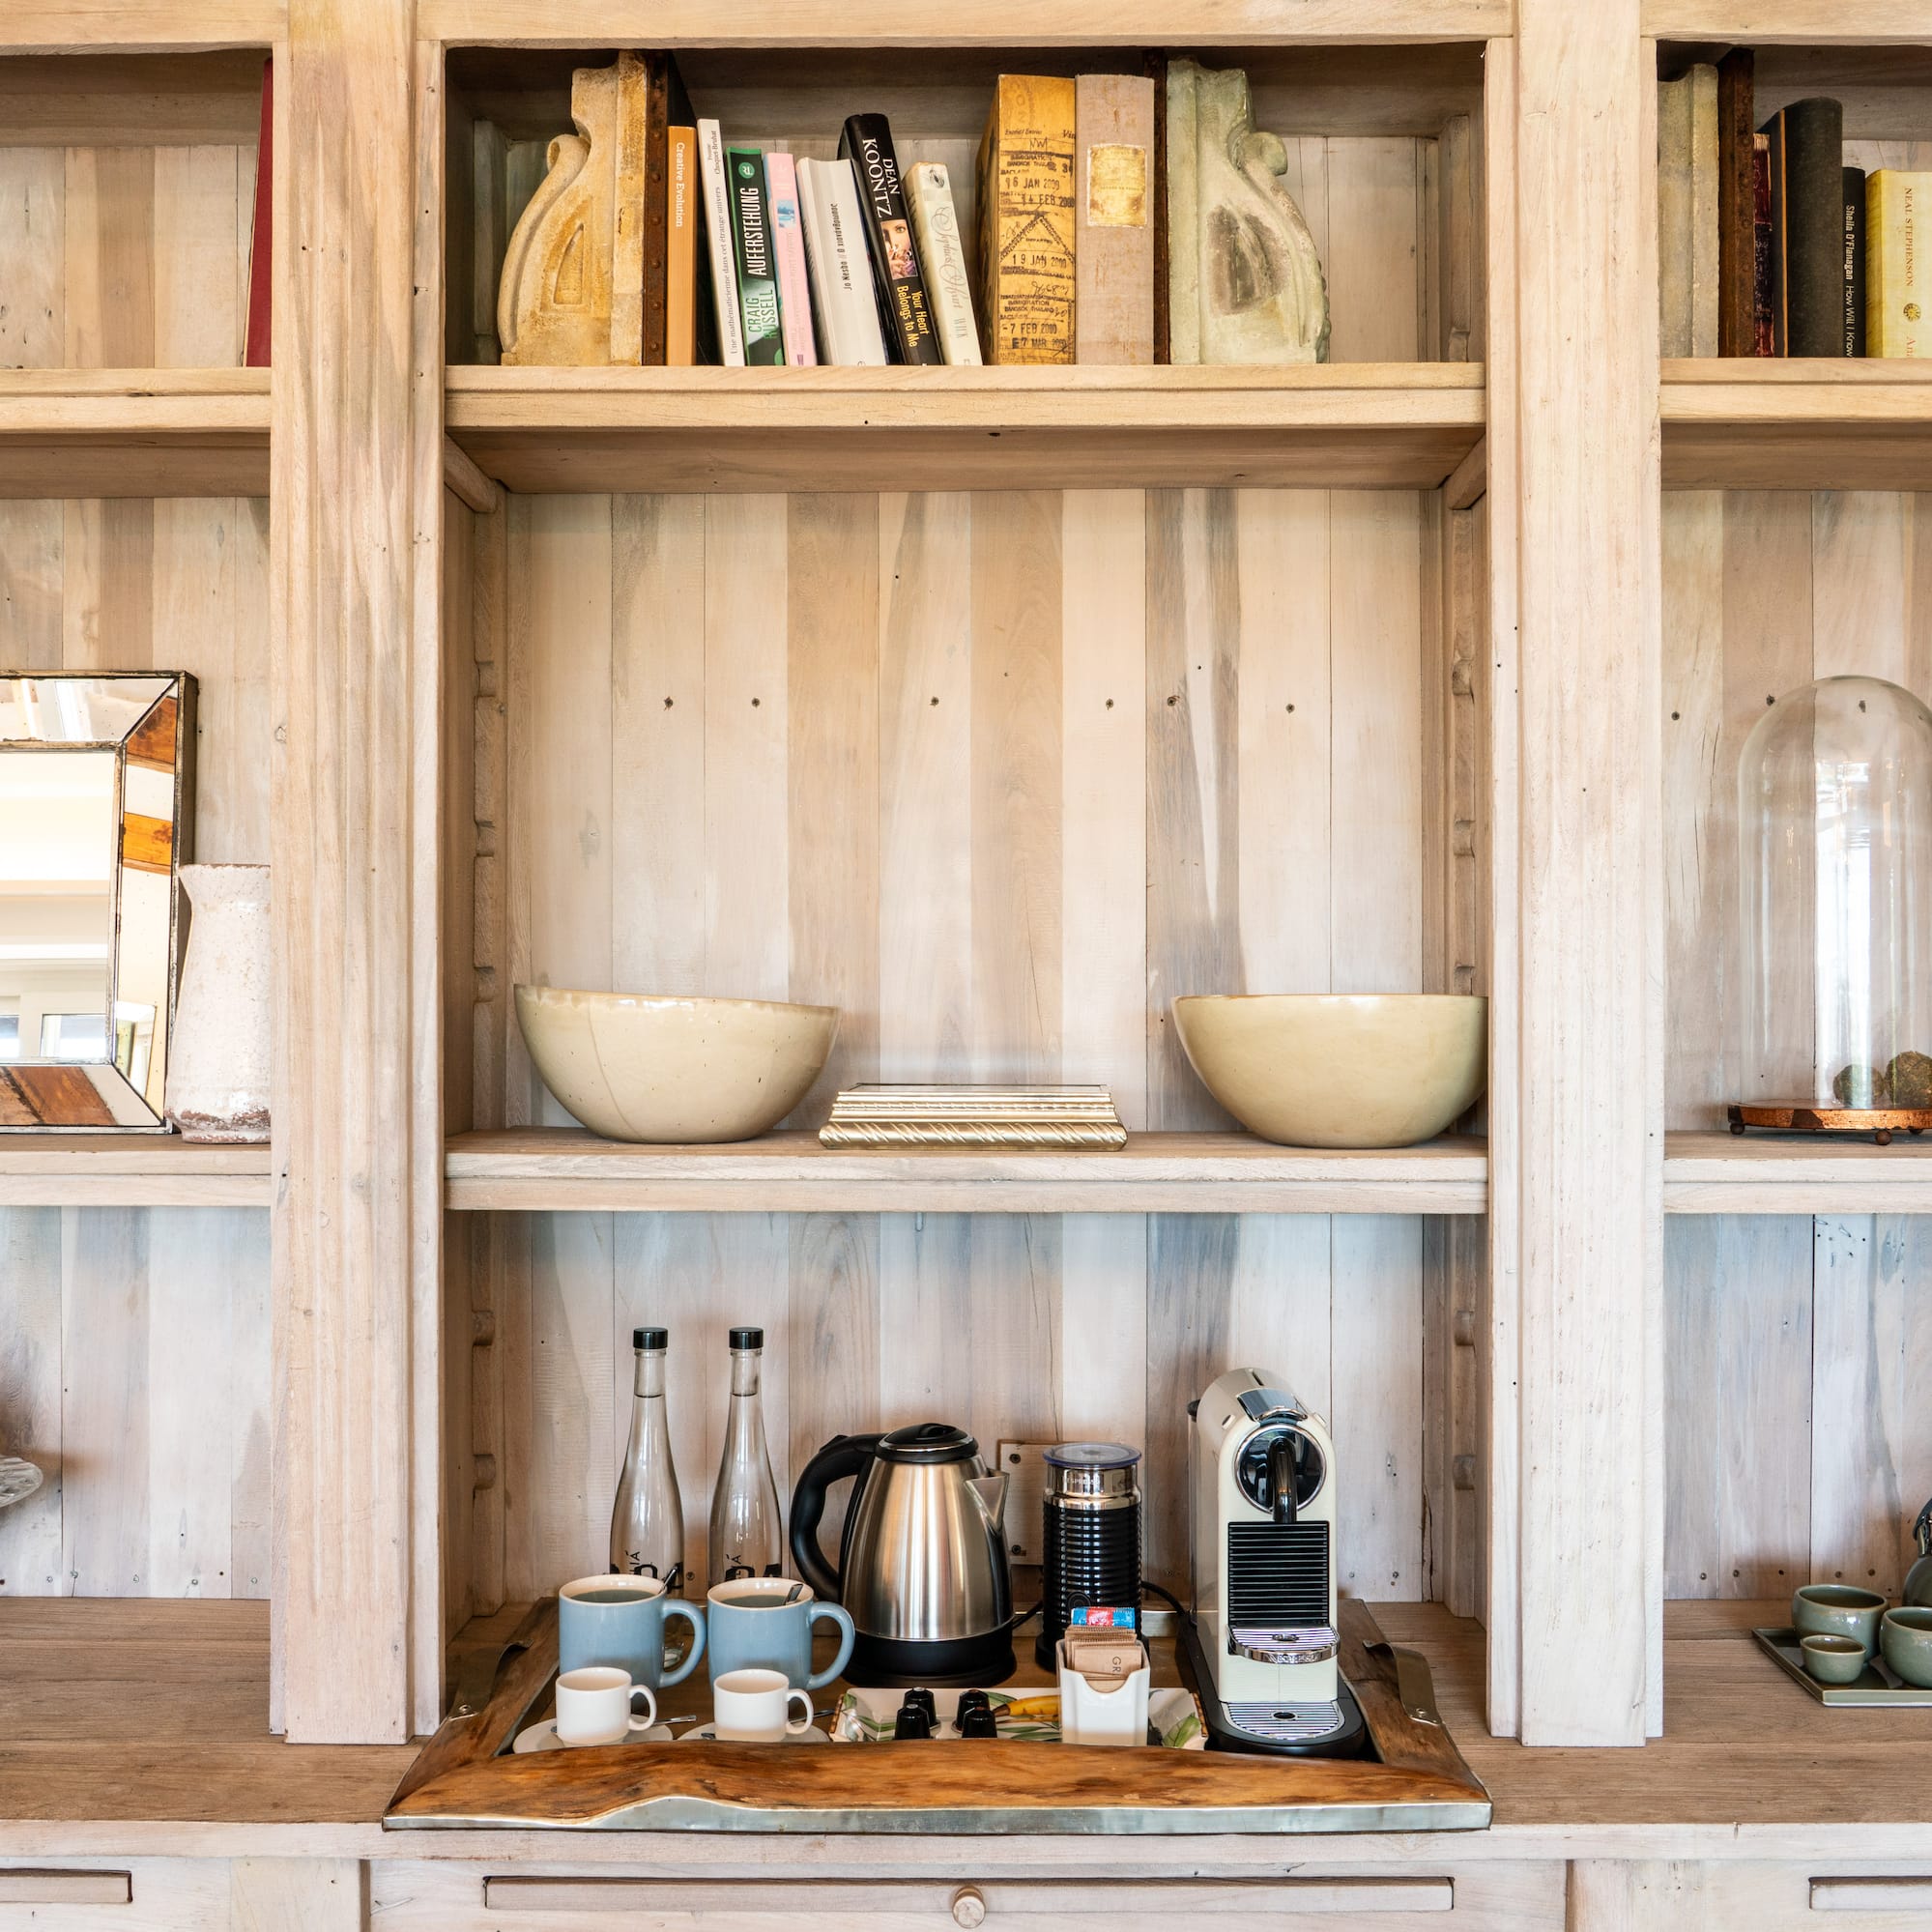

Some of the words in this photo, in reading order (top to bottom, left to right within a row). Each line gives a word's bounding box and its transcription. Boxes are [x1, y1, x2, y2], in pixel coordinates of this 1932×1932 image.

[675, 142, 685, 181] Creative
[862, 137, 893, 218] KOONTZ
[882, 158, 900, 194] DEAN
[1024, 177, 1040, 188] JAN
[675, 183, 685, 227] Evolution
[713, 187, 724, 214] univers
[1904, 187, 1914, 215] NEAL
[716, 215, 729, 243] étrange
[739, 187, 767, 275] AUFERSTEHUNG
[1845, 205, 1855, 231] Sheila
[719, 244, 728, 255] cet
[1012, 253, 1026, 266] 19
[1030, 254, 1047, 269] JAN
[1843, 233, 1855, 280] O'Flanagan
[1904, 217, 1915, 287] STEPHENSON
[721, 256, 730, 274] dans
[843, 282, 852, 291] Jo
[1845, 285, 1855, 306] How
[723, 274, 736, 337] mathématicienne
[896, 285, 913, 320] Belongs
[911, 291, 924, 309] Your
[745, 298, 763, 333] CRAIG
[759, 289, 777, 339] RUSSELL
[904, 322, 915, 332] to
[915, 311, 930, 335] Heart
[1845, 307, 1855, 325] Will
[907, 333, 918, 348] Me
[1021, 323, 1037, 334] FEB
[1041, 323, 1057, 334] 2000
[729, 338, 738, 355] Une
[1845, 332, 1855, 358] Know
